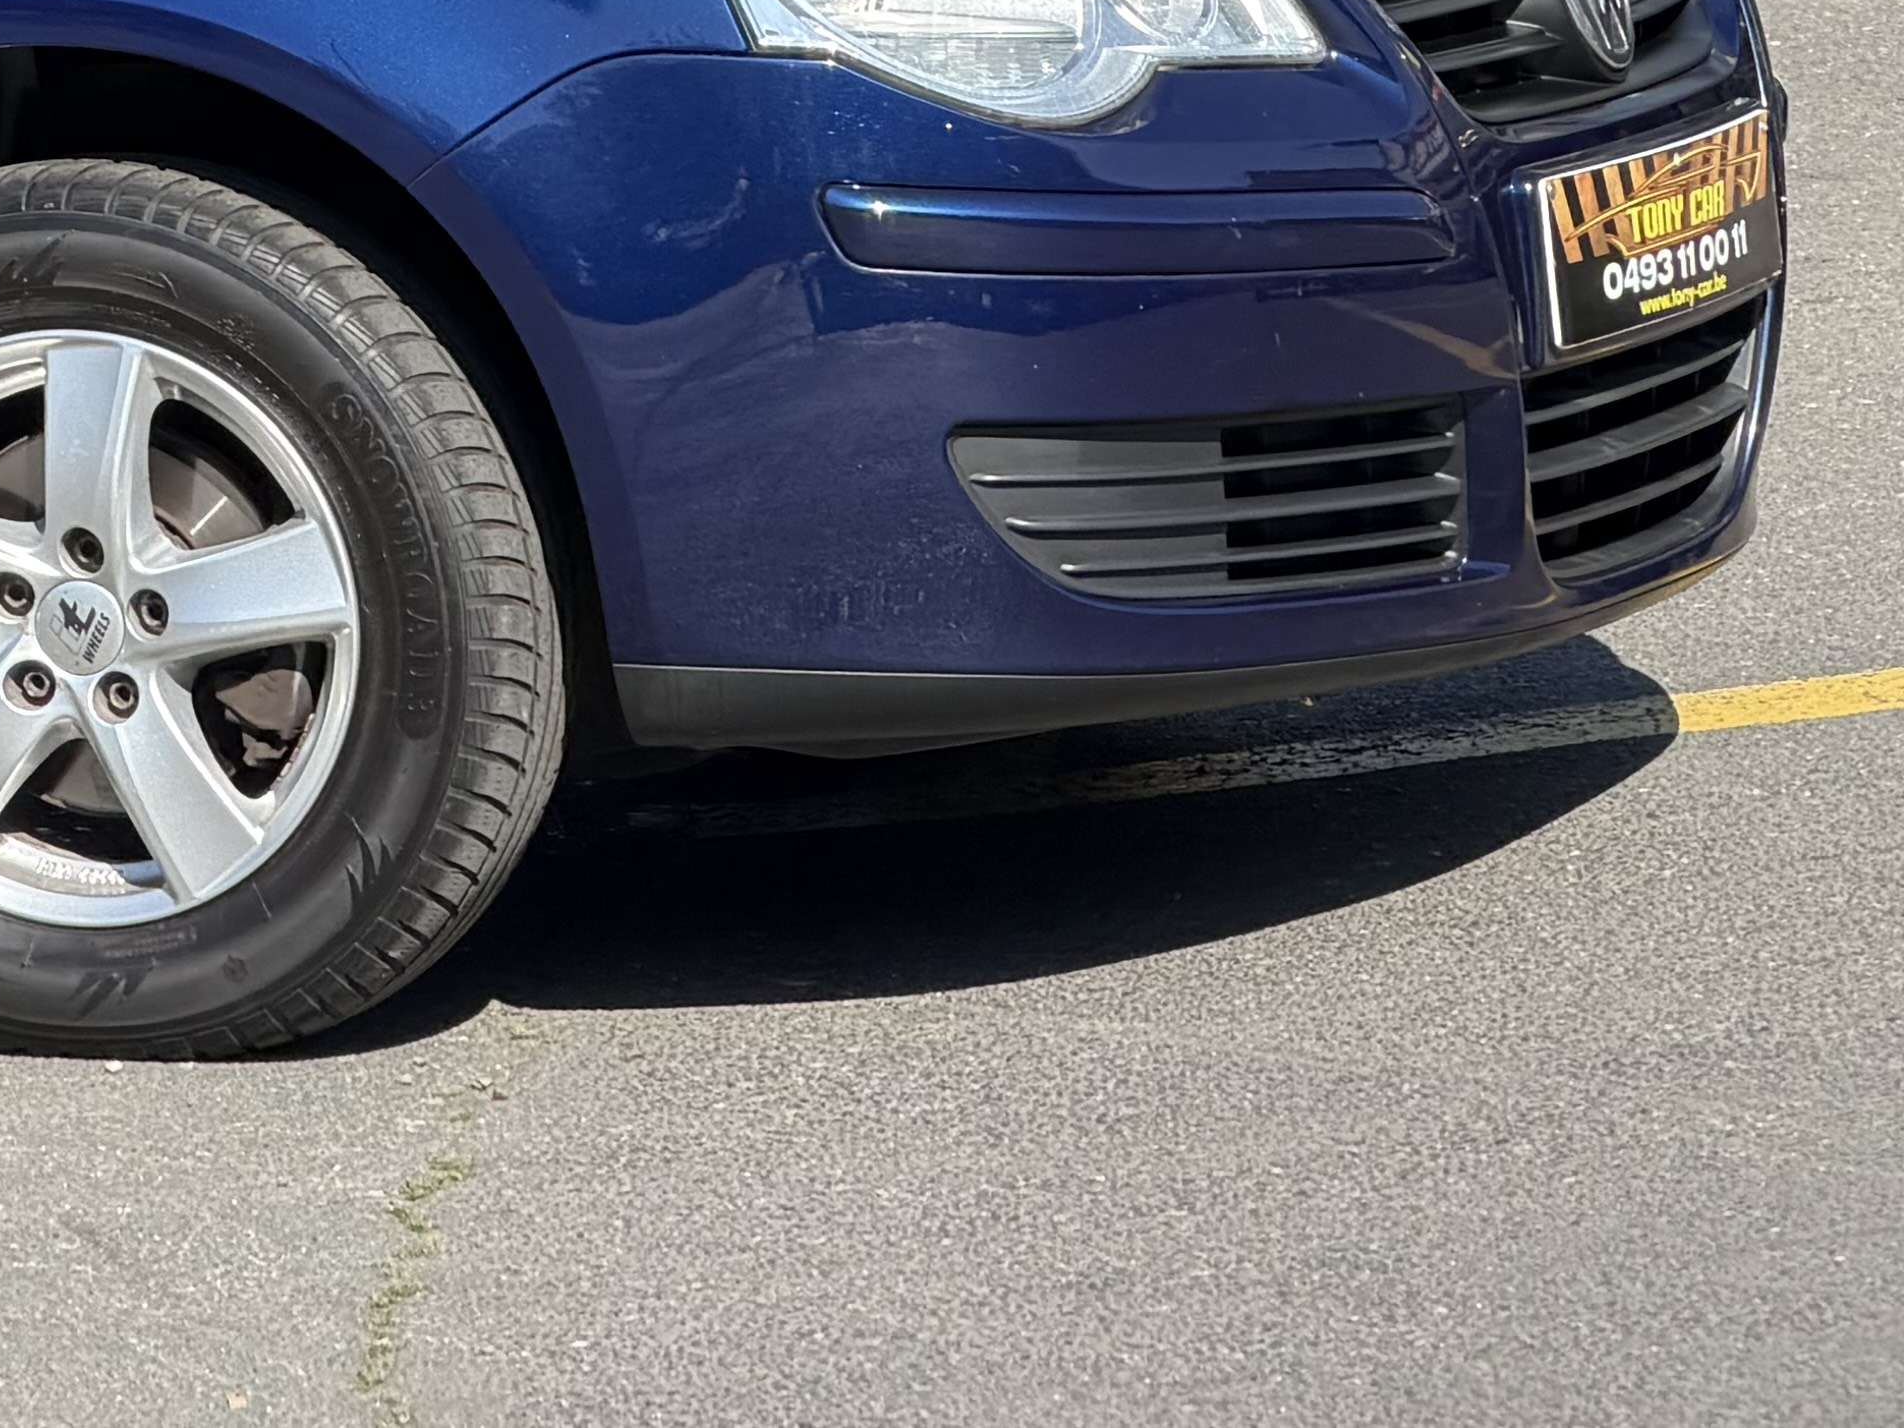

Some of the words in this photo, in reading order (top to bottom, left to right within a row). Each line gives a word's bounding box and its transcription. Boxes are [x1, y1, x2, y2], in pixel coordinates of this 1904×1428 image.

[1625, 194, 1684, 244] TONY
[1690, 179, 1726, 226] CAR
[1602, 247, 1673, 300] 0493
[1677, 242, 1697, 280] 11
[1699, 228, 1730, 272] 00
[1731, 219, 1748, 259] 11
[82, 612, 111, 664] WHEELS
